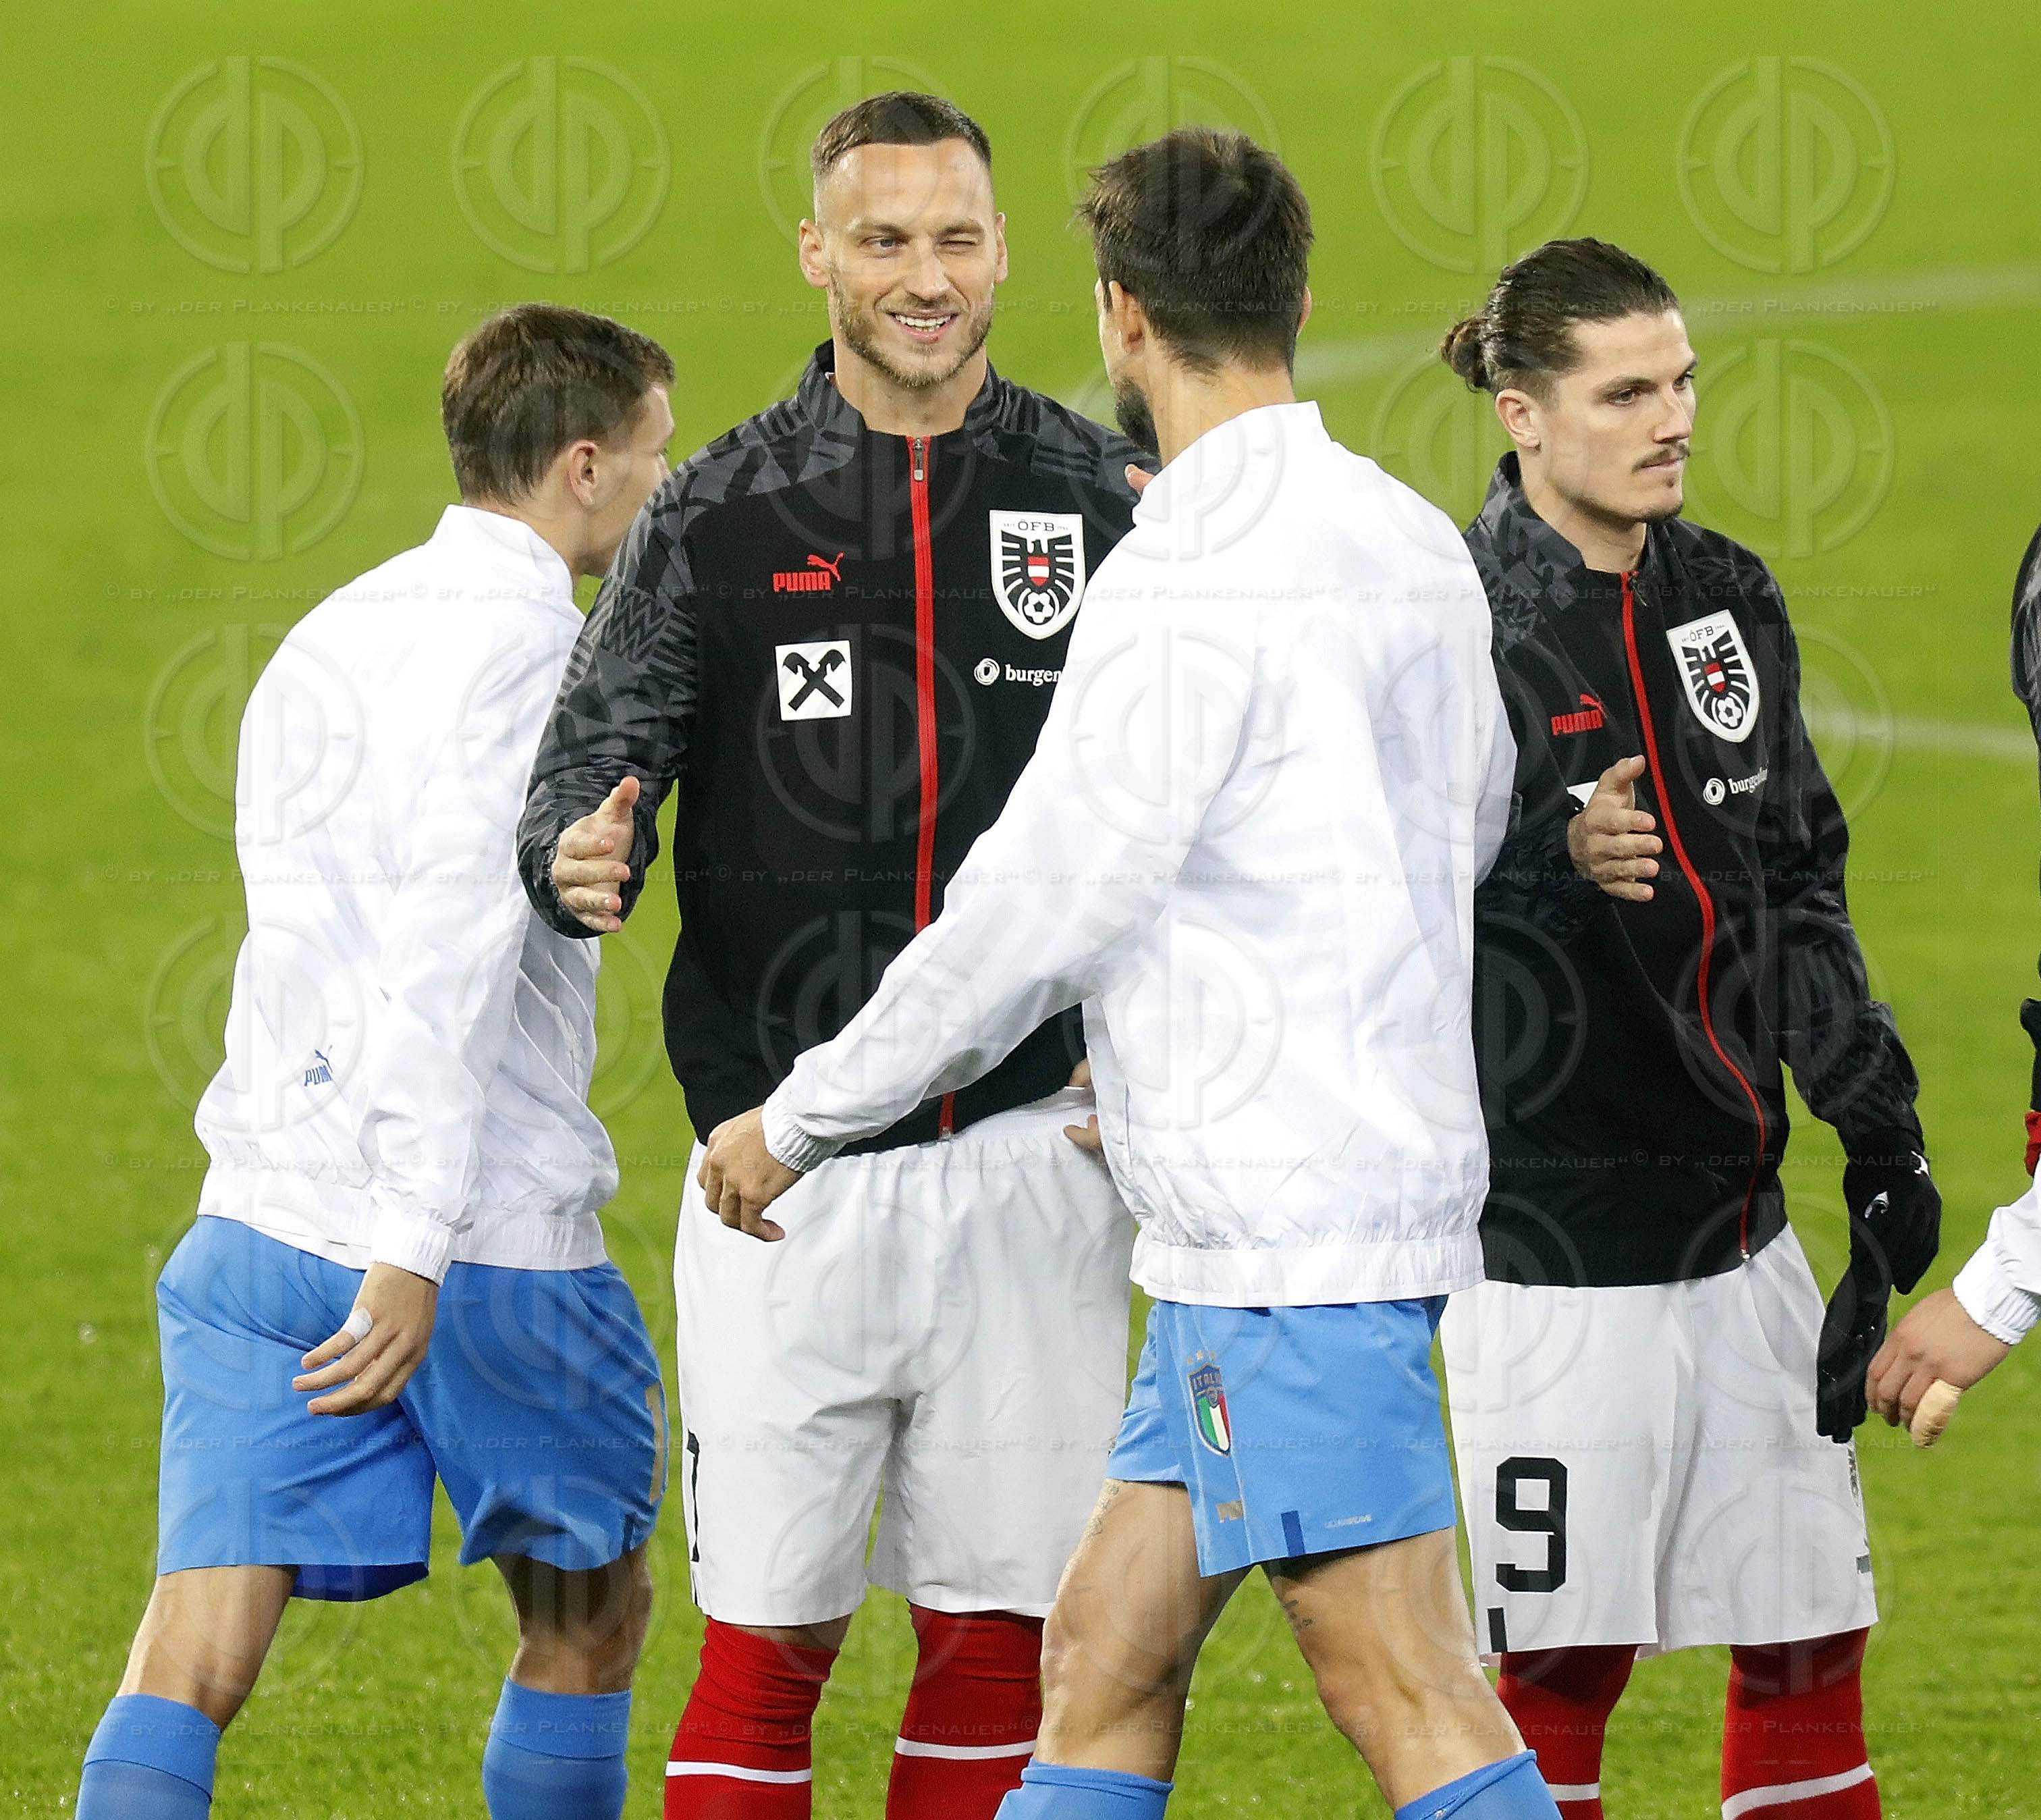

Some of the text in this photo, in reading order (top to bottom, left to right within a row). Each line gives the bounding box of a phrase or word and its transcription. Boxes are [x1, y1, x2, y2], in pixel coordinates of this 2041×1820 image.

[1018, 518, 1054, 532] ÖFB
[772, 570, 832, 593] PUMA
[1550, 709, 1604, 735] PUMA
[304, 1064, 333, 1087] PUM
[1496, 1455, 1568, 1593] 9
